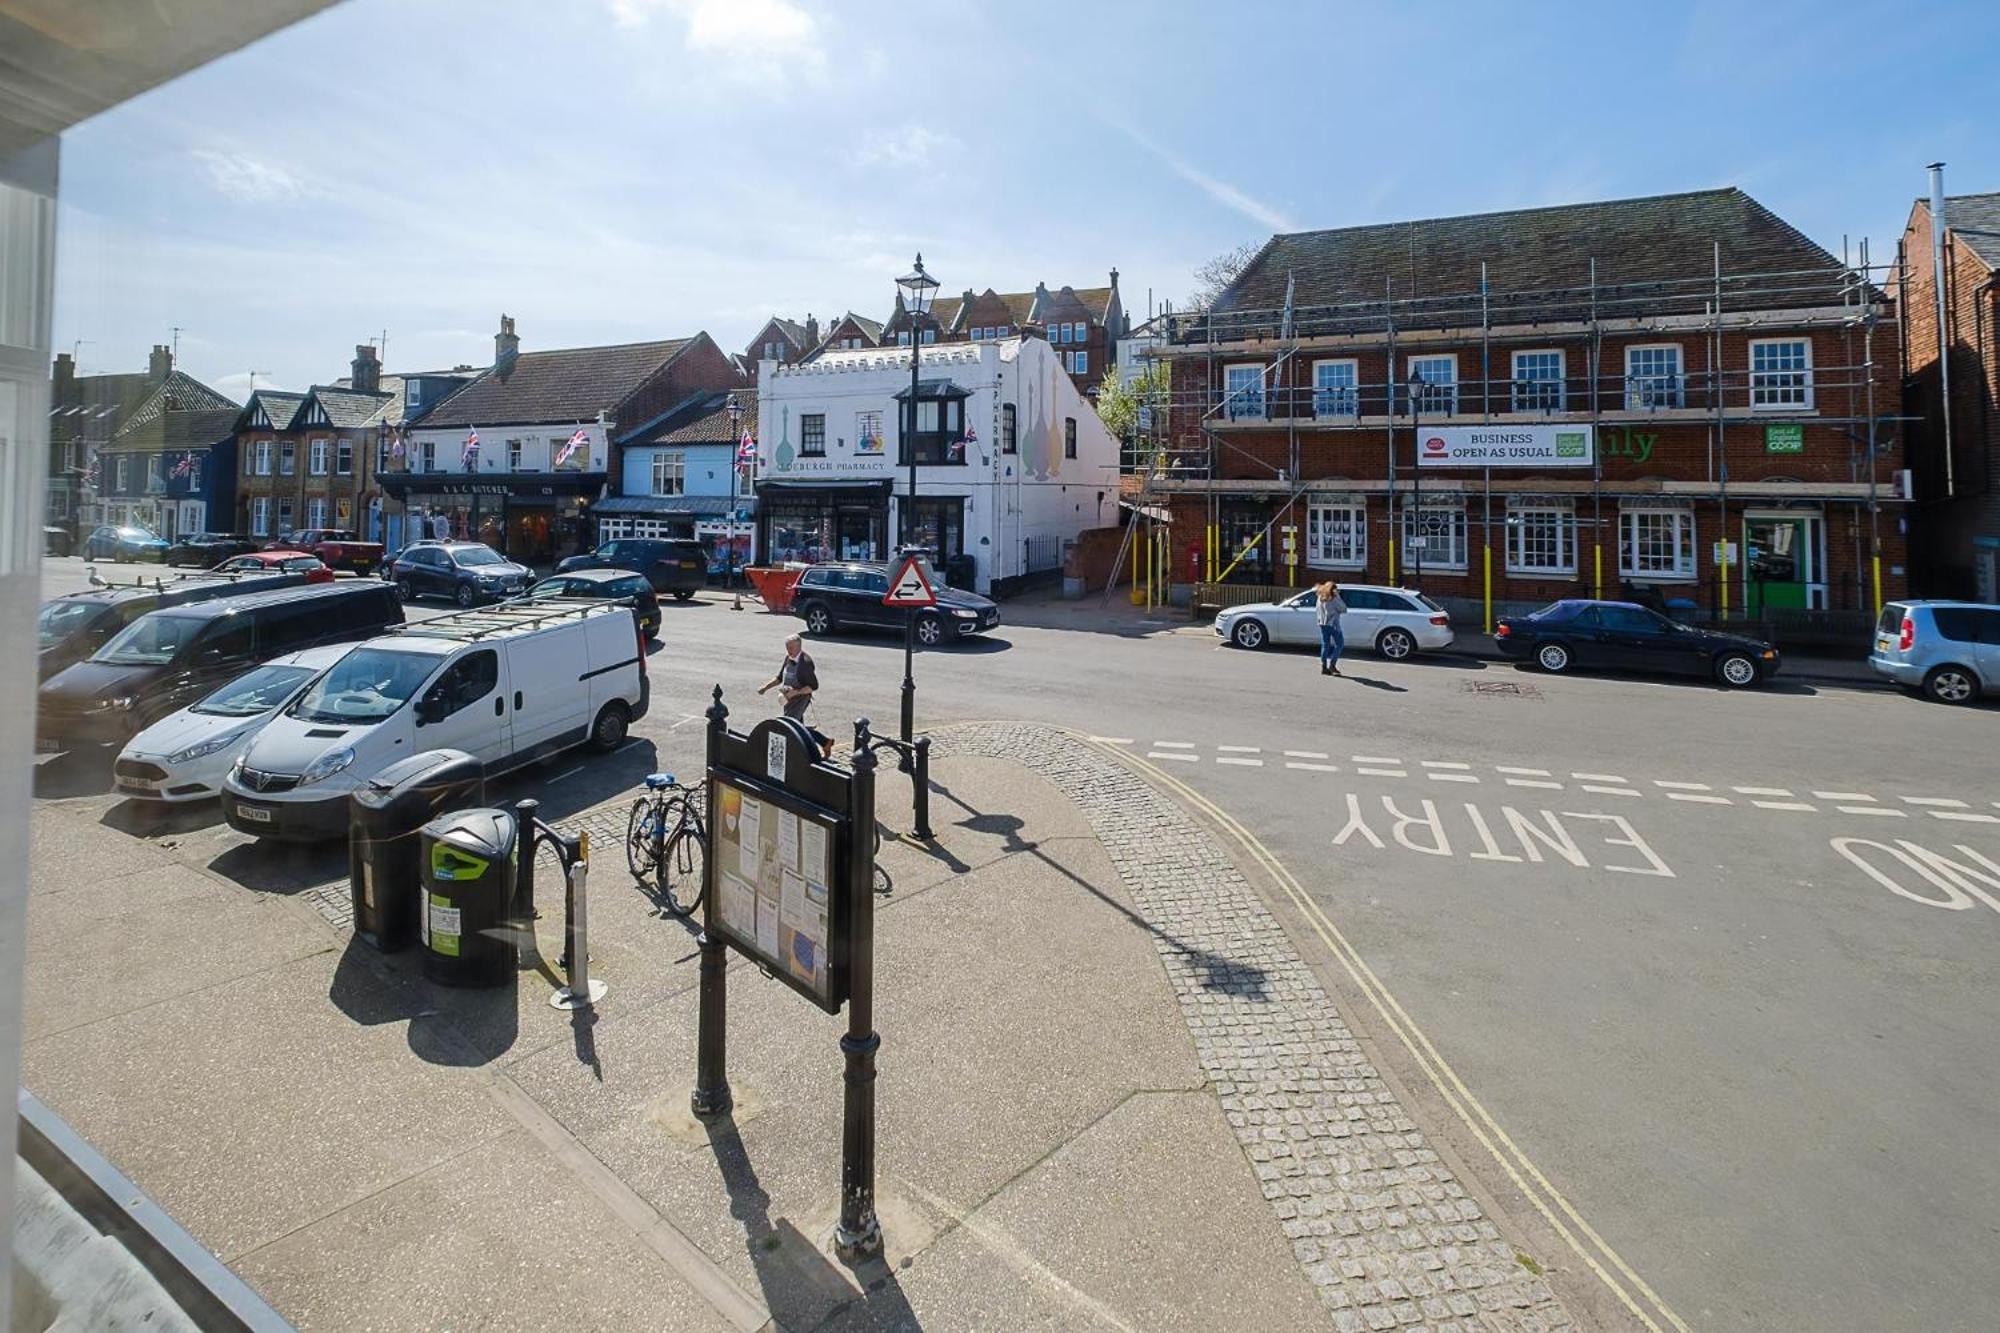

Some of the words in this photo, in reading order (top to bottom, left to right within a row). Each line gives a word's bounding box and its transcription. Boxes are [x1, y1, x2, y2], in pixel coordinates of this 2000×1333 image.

[1471, 433, 1533, 445] BUSINESS
[1452, 447, 1487, 458] OPEN
[1490, 447, 1506, 457] AS
[1509, 446, 1553, 457] USUAL
[836, 463, 885, 471] PHARMACY
[1332, 793, 1676, 879] ENTRY
